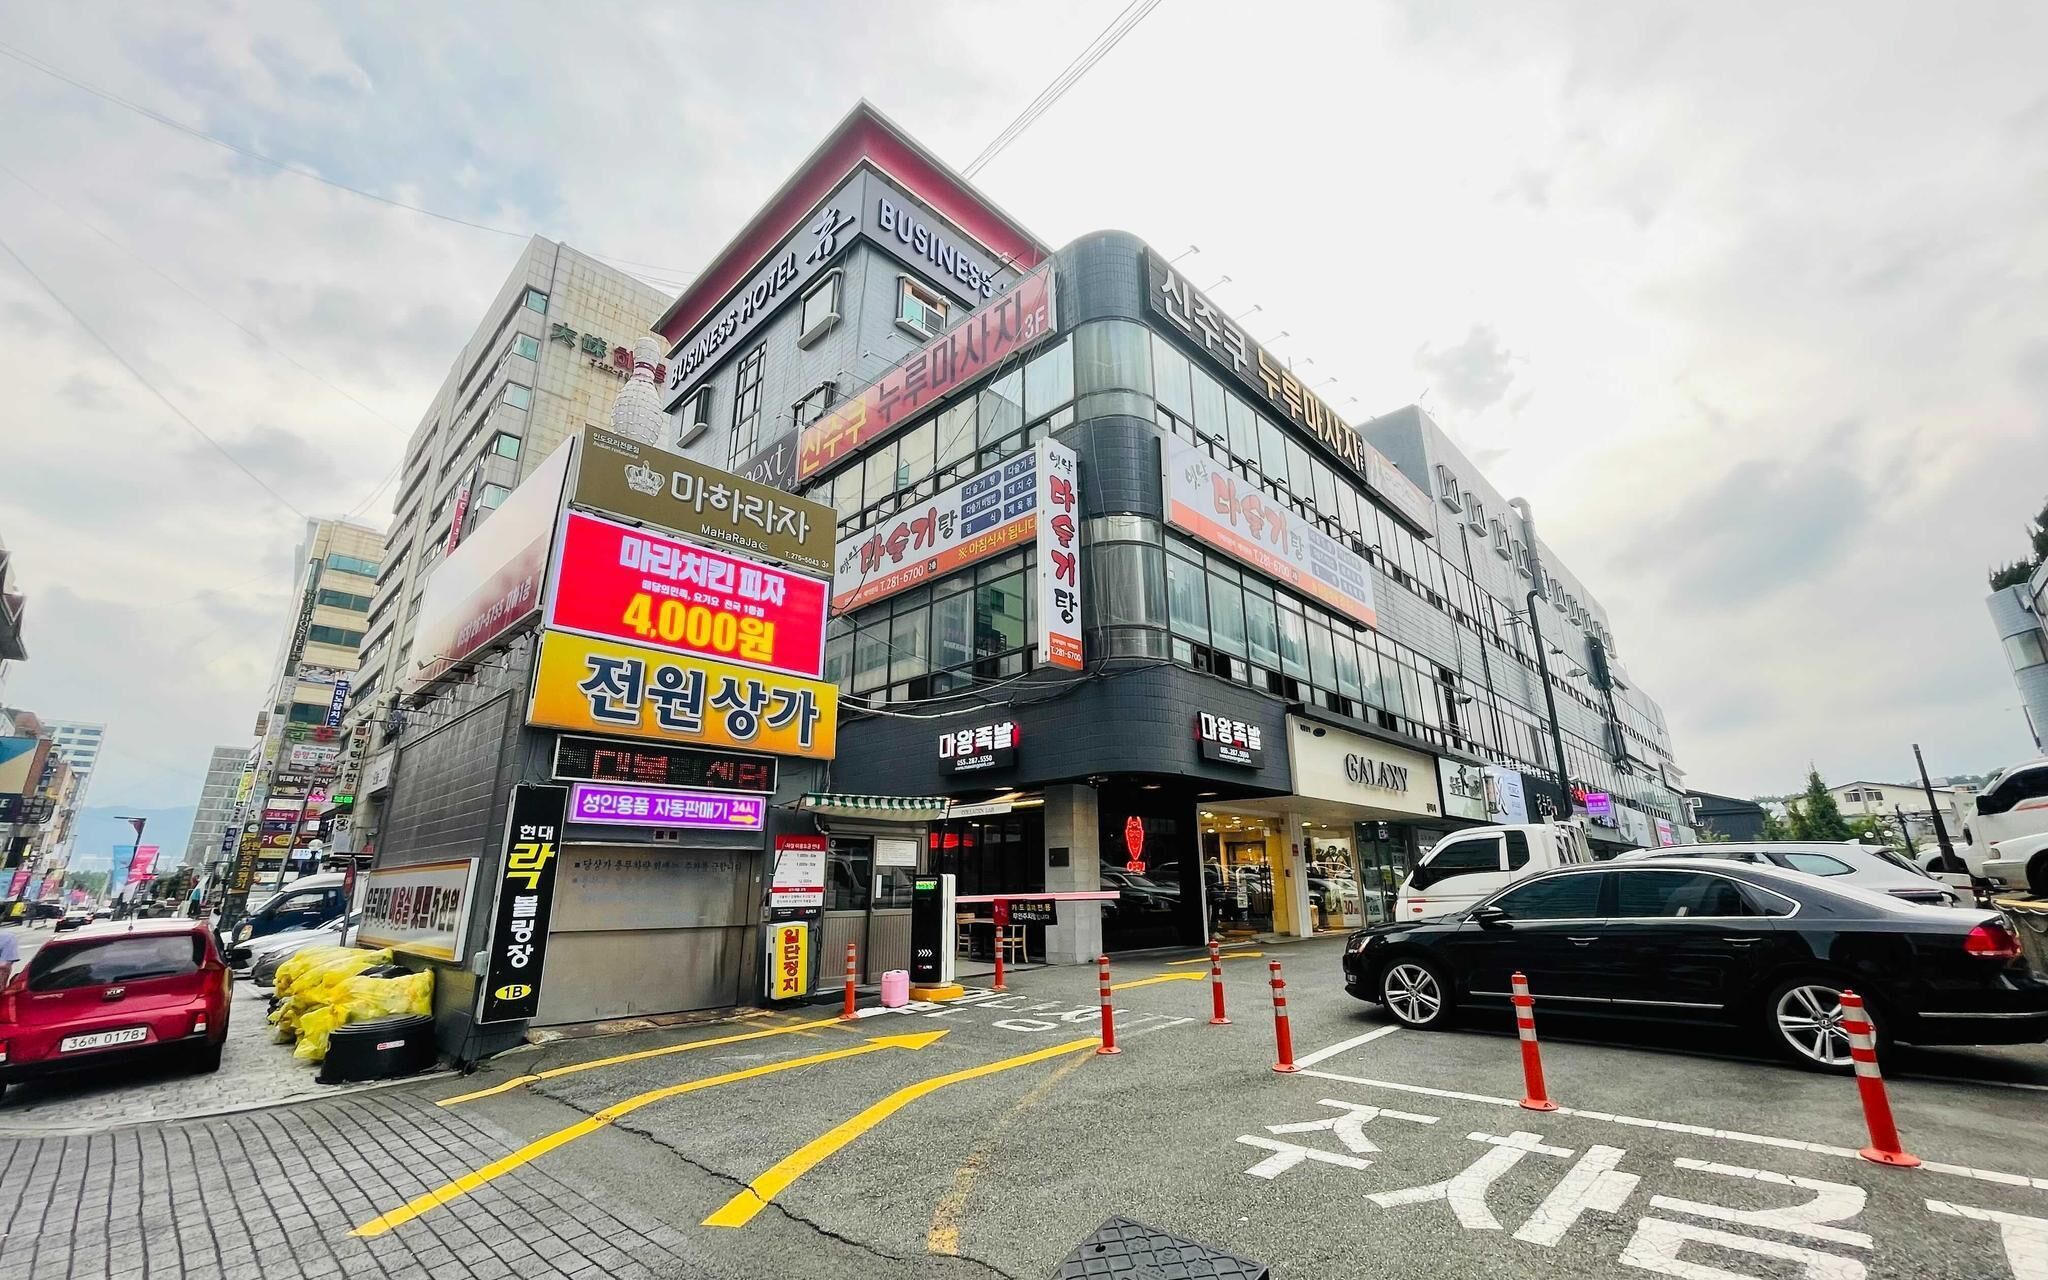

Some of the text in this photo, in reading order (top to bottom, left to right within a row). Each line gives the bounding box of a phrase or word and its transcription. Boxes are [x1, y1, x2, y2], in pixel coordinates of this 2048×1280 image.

[879, 198, 994, 298] BUSINESS
[669, 310, 738, 390] BUSINESS
[741, 252, 799, 324] HOTEL
[878, 290, 1021, 422] 누루마사지
[1025, 306, 1045, 339] 3F
[1160, 269, 1248, 372] 신주쿠
[1257, 347, 1361, 471] 누루마사지
[671, 471, 811, 545] 마하라자
[701, 523, 759, 549] MaHaRaJa
[619, 534, 786, 607] 마라치킨 피자
[880, 565, 924, 592] T.281-6700
[622, 592, 775, 662] 4,000원
[578, 654, 820, 750] 전원상가
[939, 721, 1014, 758] 마왕족발
[1200, 711, 1262, 751] 마왕족발
[1345, 753, 1408, 792] GALAXY
[520, 824, 555, 841] 현대
[583, 793, 755, 819] 성인용품 자동판매기 24시
[506, 843, 555, 889] 락
[507, 895, 538, 969] 볼링장
[783, 929, 801, 992] 일단정지
[503, 986, 524, 999] 1B
[69, 1030, 139, 1049] 36어 0178
